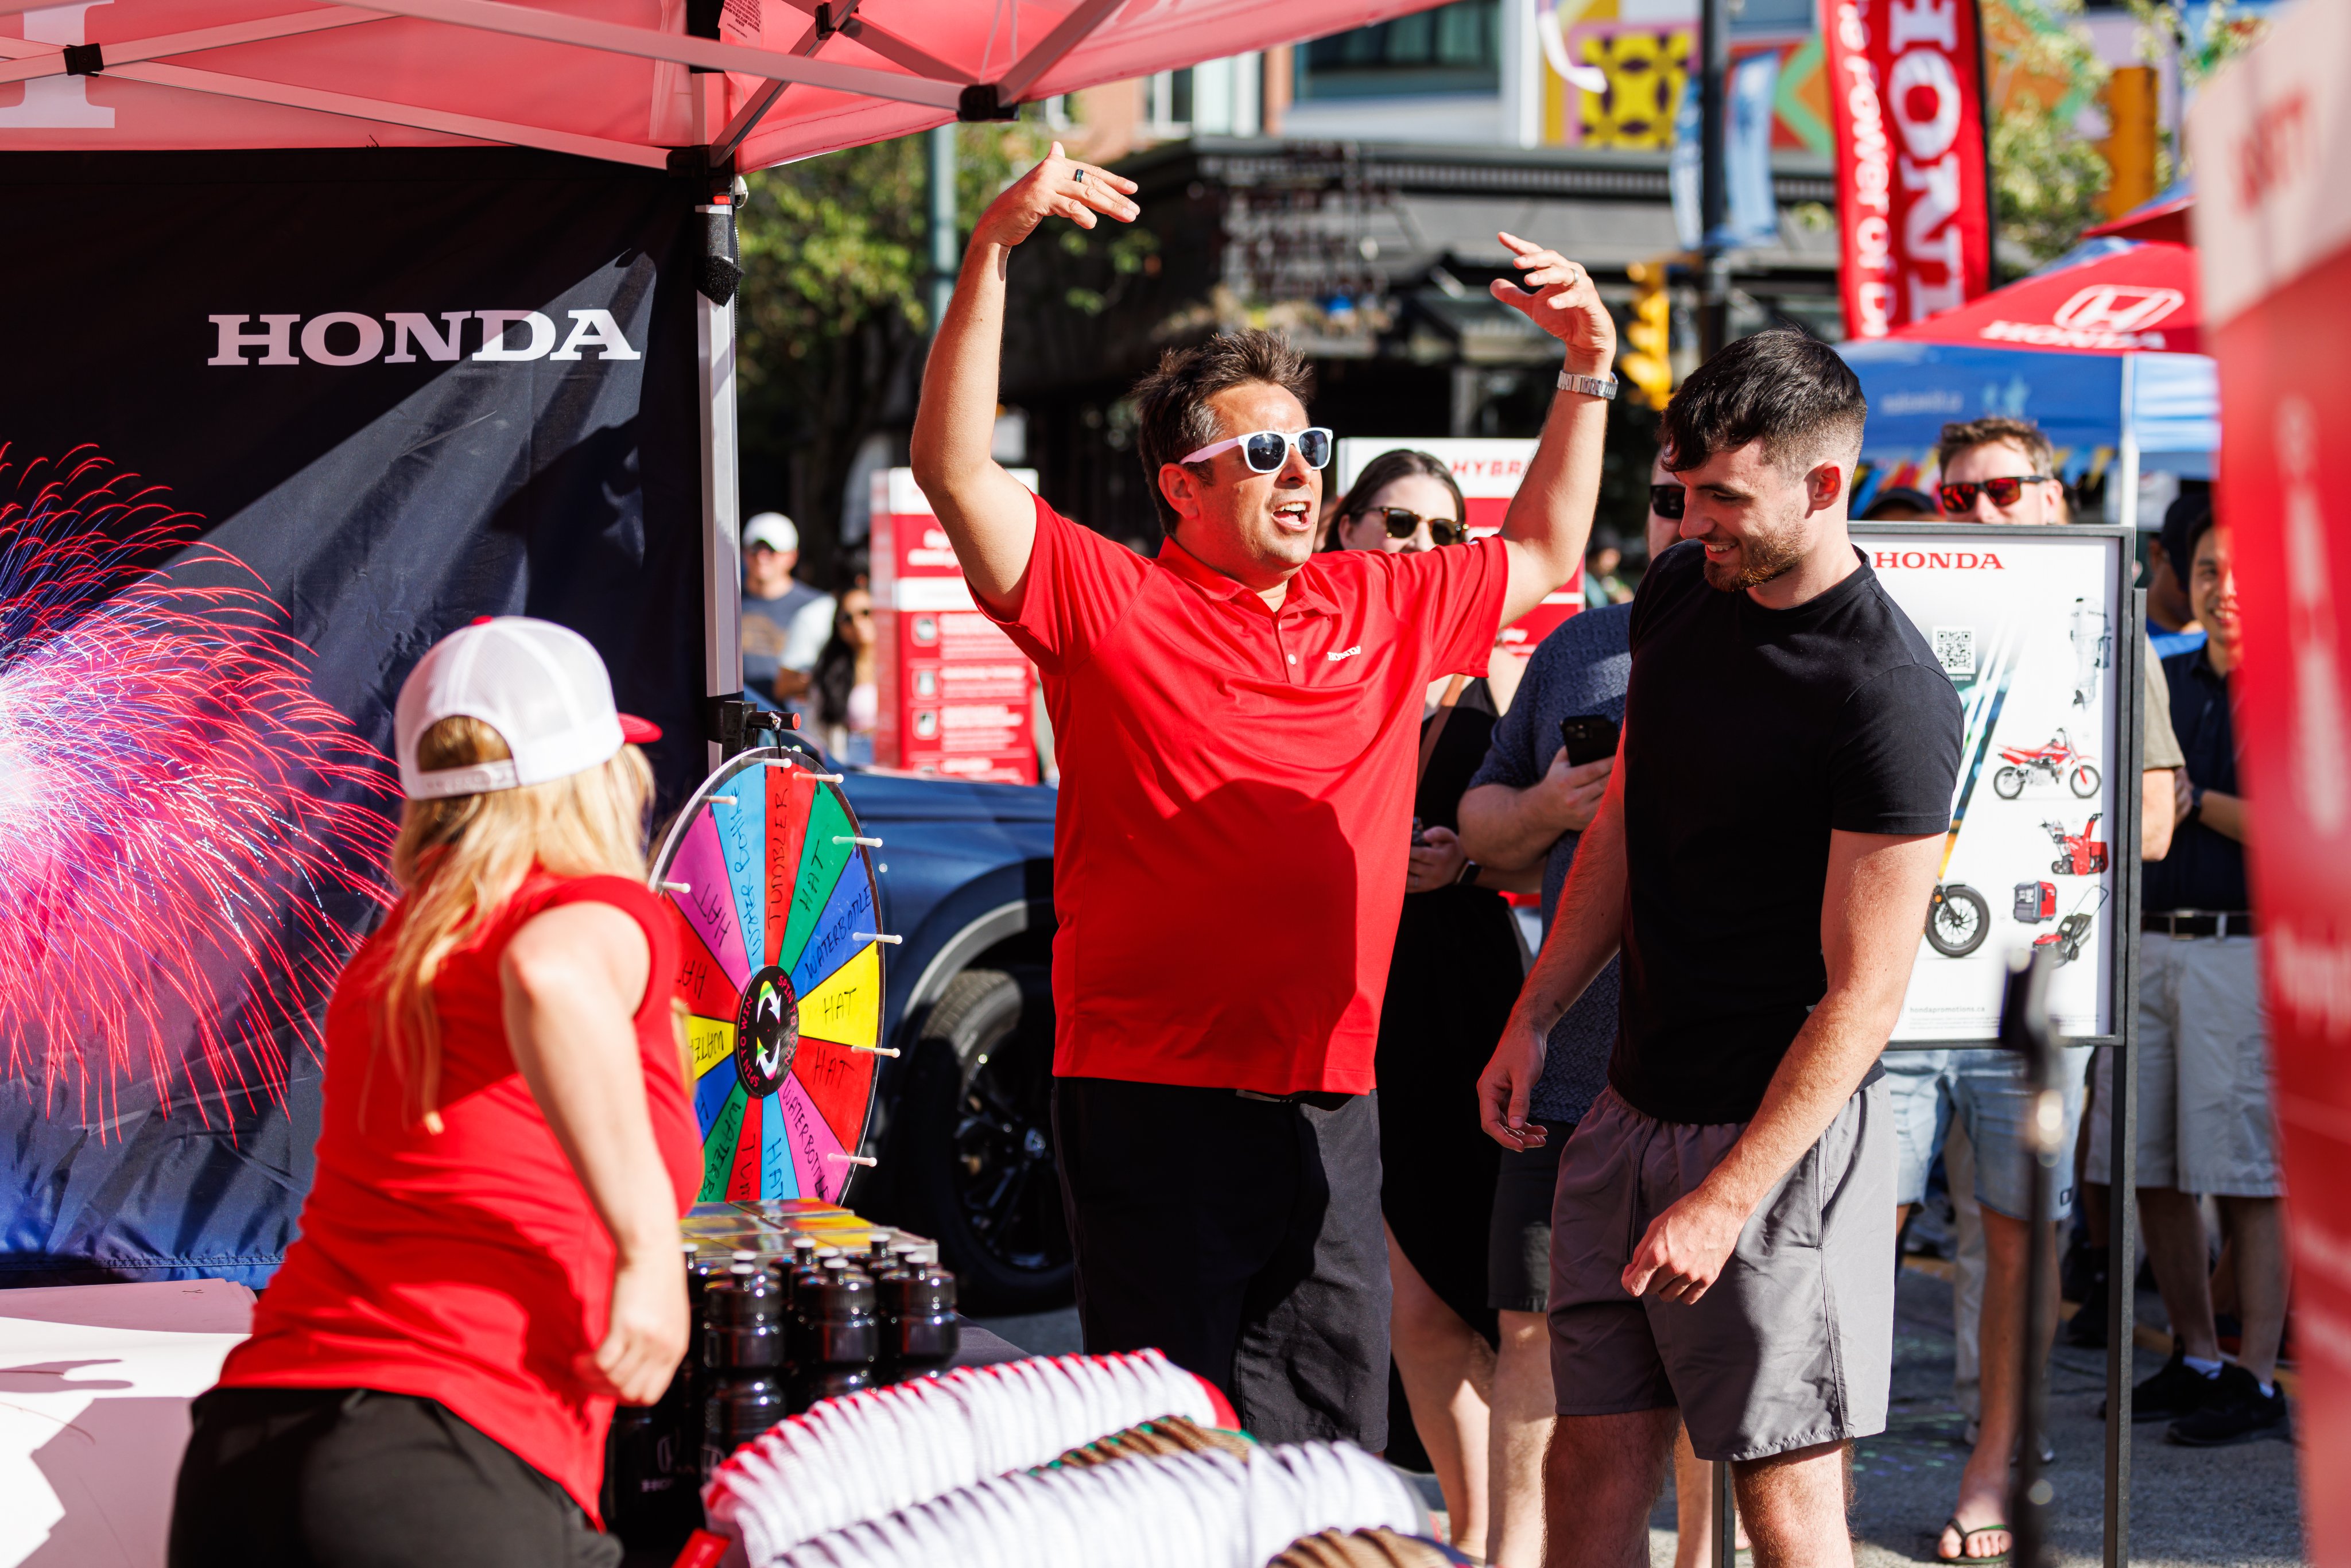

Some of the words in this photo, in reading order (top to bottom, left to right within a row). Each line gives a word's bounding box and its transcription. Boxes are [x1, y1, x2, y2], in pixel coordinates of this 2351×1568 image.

[208, 309, 641, 366] HONDA
[1873, 552, 2005, 569] HONDA
[767, 788, 788, 930] TUMBLER
[798, 839, 825, 913] HAT
[690, 883, 731, 948] HAT
[677, 960, 707, 1000] HA
[777, 976, 794, 1003] SPIN
[740, 996, 754, 1031] WIN
[790, 1007, 797, 1026] TO
[824, 987, 857, 1025] HAT
[1910, 1006, 1985, 1014] hondapromotions.ca
[739, 1035, 747, 1057] TO
[784, 1032, 797, 1066] WIN
[742, 1062, 760, 1088] SPIN
[813, 1046, 855, 1090] HAT
